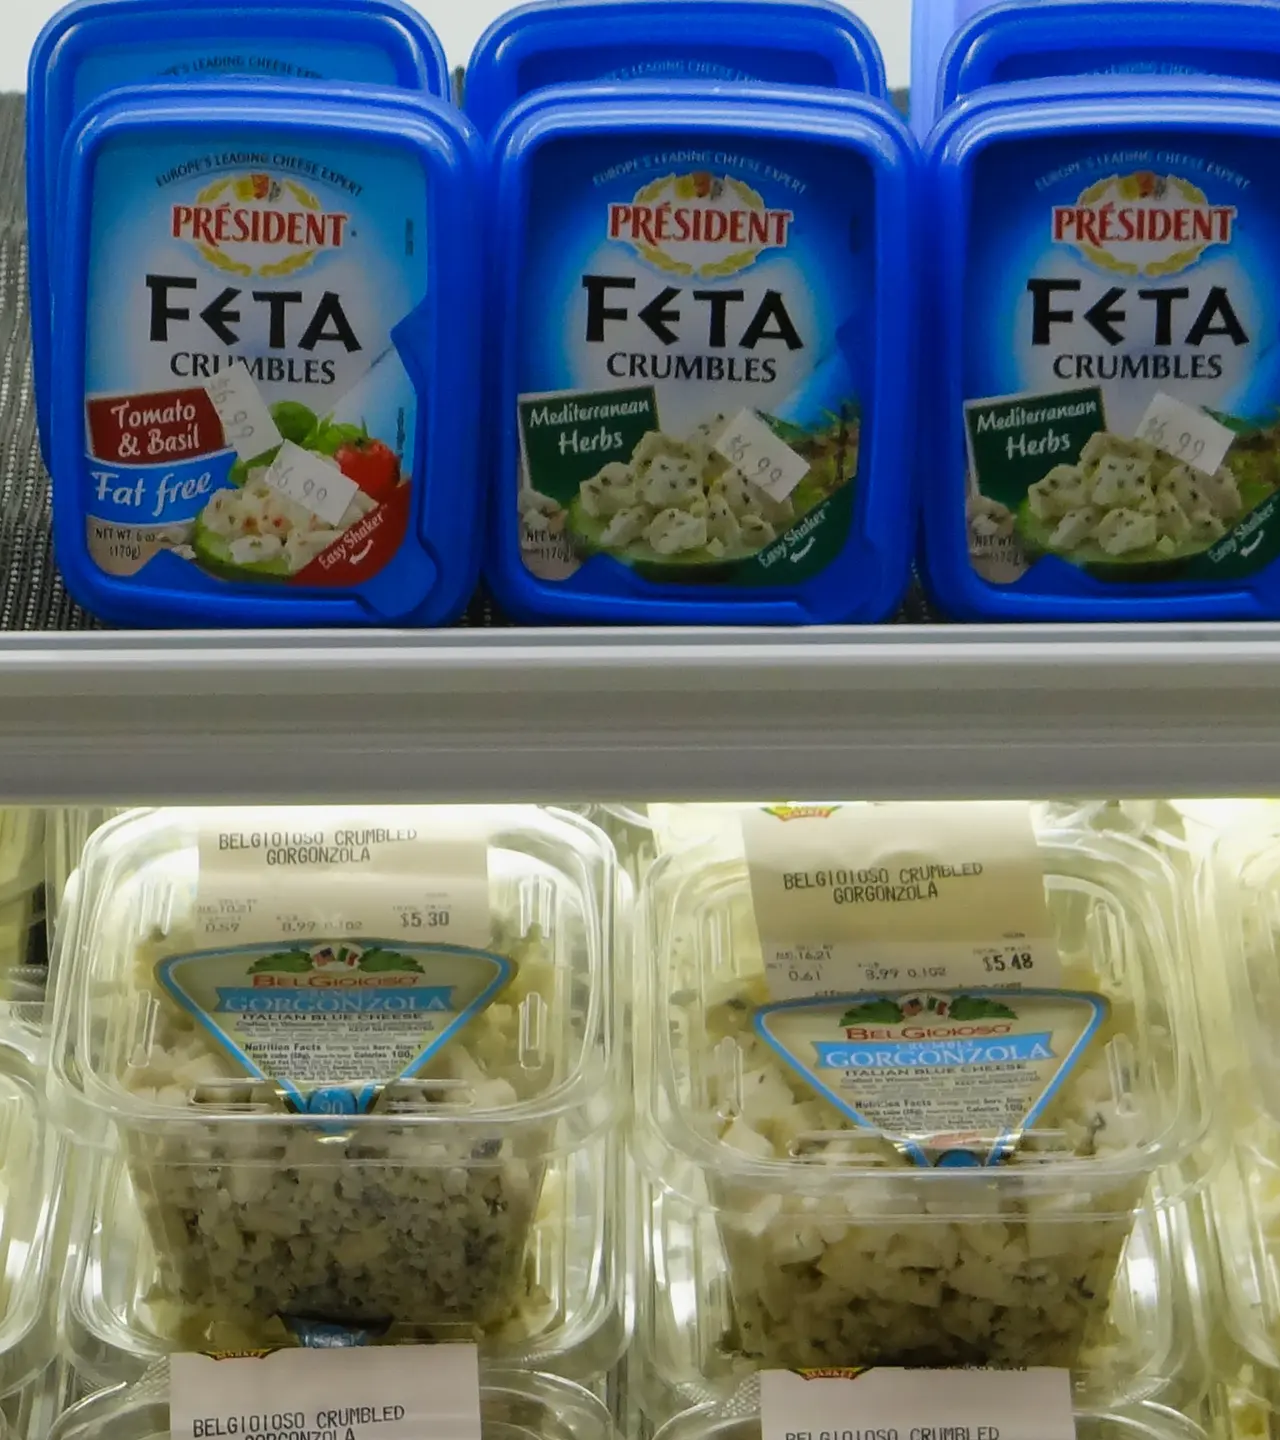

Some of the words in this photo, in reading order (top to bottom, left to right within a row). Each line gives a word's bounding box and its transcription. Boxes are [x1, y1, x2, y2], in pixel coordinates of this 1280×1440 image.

[172, 203, 348, 248] PRÉSIDENT
[609, 202, 791, 246] PRÉSIDENT
[1054, 203, 1234, 246] PRÉSIDENT
[145, 274, 362, 353] FETA
[582, 275, 804, 351] FETA
[1027, 278, 1250, 346] FETA
[607, 352, 777, 384] CRUMBLES
[1053, 353, 1223, 381] CRUMBLES
[111, 400, 196, 428] Tomato
[529, 398, 650, 426] Mediterranean
[977, 400, 1097, 433] Mediterranean
[118, 435, 140, 457] &
[147, 424, 200, 455] Basil
[558, 428, 623, 456] Herbs
[1005, 434, 1071, 460] Herbs
[91, 471, 146, 506] Fat
[153, 469, 212, 516] free
[335, 828, 417, 846] CRUMBLED
[266, 846, 371, 866] GORGONZOLA
[899, 862, 983, 882] CRUMBLED
[833, 883, 939, 904] GORGONZOLA
[400, 911, 450, 928] $5.30
[983, 953, 1033, 972] $5.48
[825, 1043, 1052, 1068] GORGONZOLA
[193, 1413, 306, 1439] BELGIOIOSO
[316, 1405, 405, 1429] CRUMBLED
